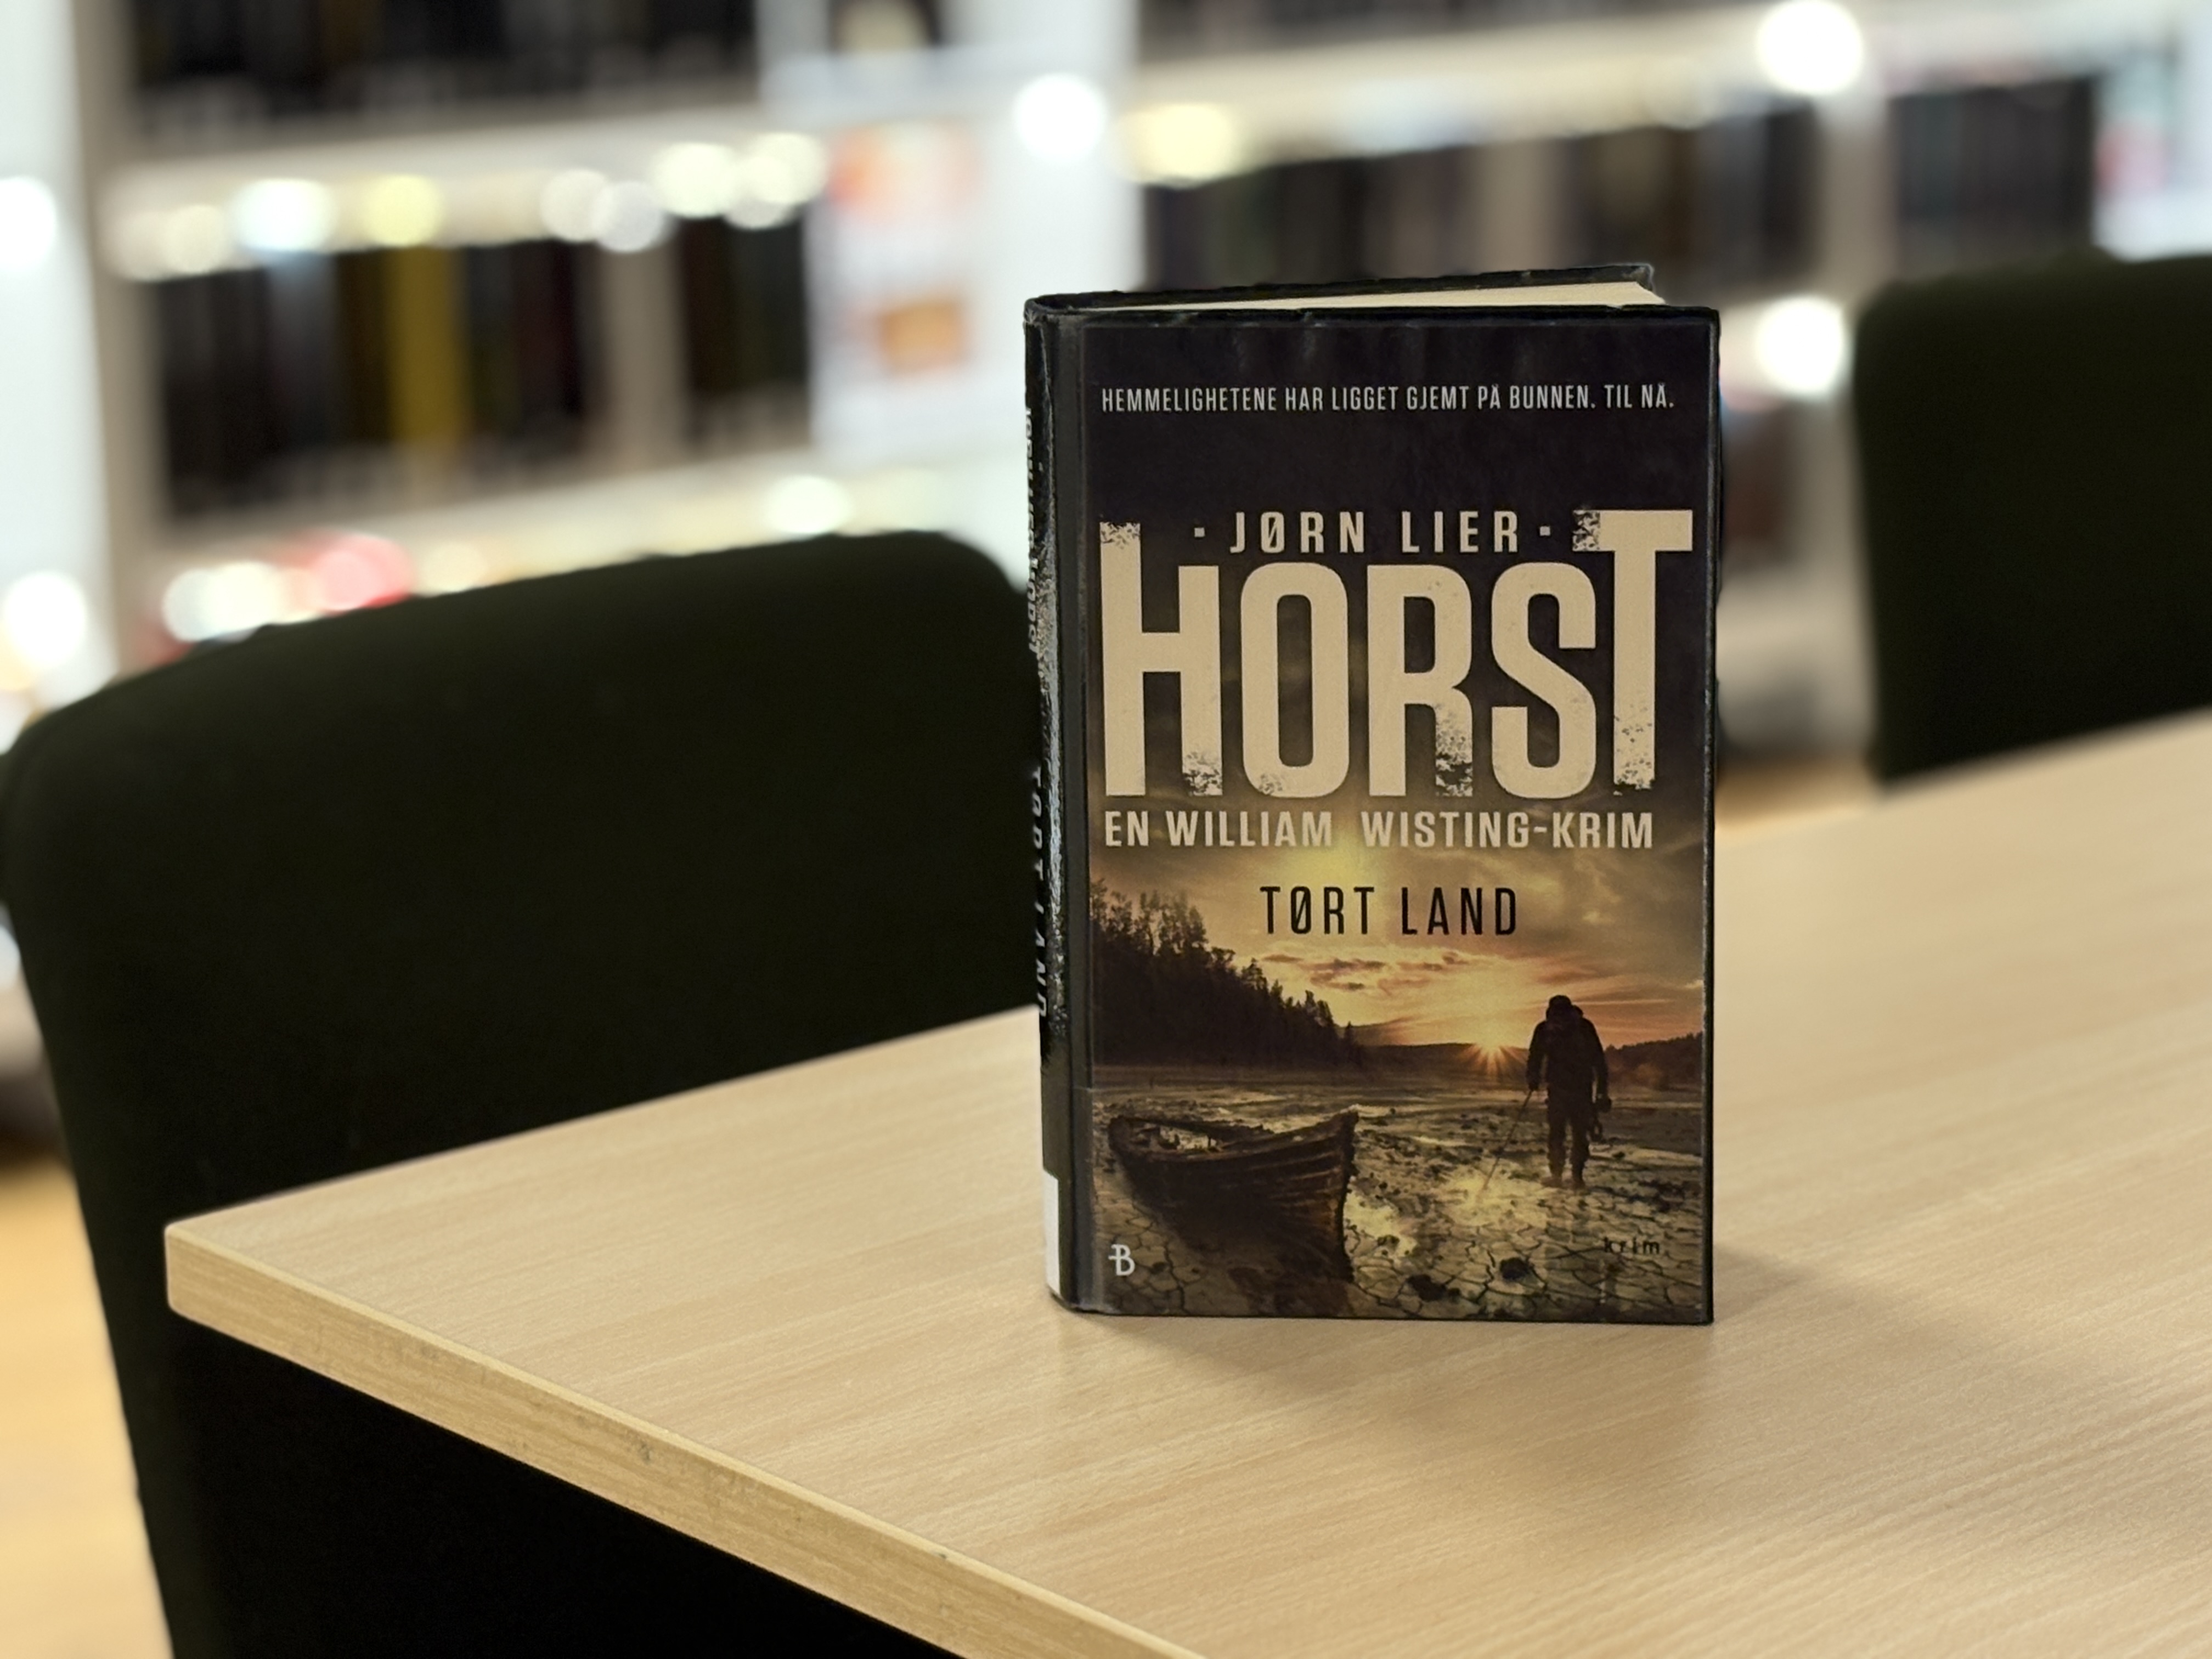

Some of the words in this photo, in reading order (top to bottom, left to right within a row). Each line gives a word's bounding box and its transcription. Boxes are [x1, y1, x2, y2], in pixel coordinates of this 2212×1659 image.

[1102, 388, 1277, 412] HEMMELIGHETENE
[1285, 387, 1323, 410] HAR
[1332, 386, 1398, 410] LIGGET
[1407, 386, 1469, 410] GJEMT
[1478, 385, 1501, 409] PÅ
[1510, 385, 1595, 409] BUNNEN.
[1604, 385, 1632, 408] TIL
[1641, 383, 1674, 408] NÅ.
[1230, 511, 1364, 553] JØRN
[1402, 511, 1519, 552] LIER
[1100, 510, 1693, 798] HORST
[1105, 811, 1149, 847] EN
[1166, 811, 1333, 848] WILLIAM
[1361, 811, 1653, 849] WISTING-KRIM
[1260, 886, 1375, 935] TØRT
[1401, 887, 1517, 936] LAND
[1604, 1237, 1660, 1254] krim
